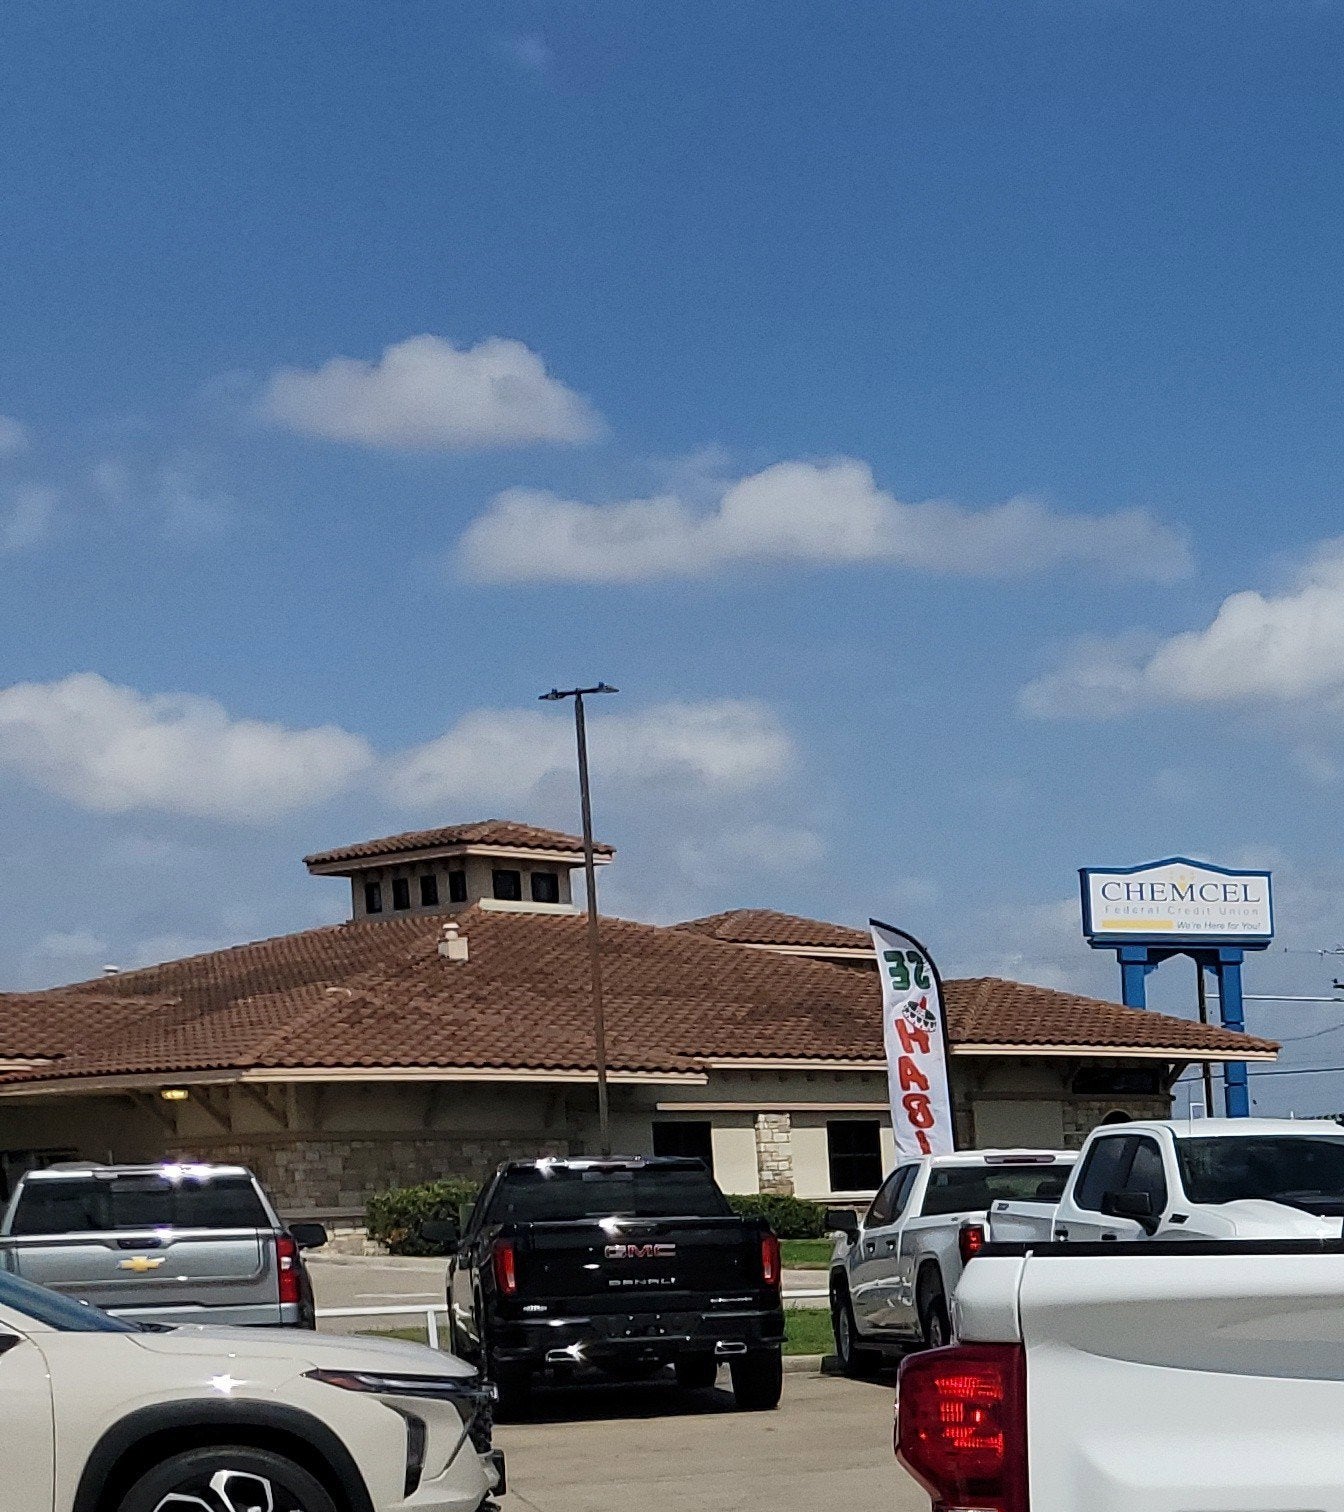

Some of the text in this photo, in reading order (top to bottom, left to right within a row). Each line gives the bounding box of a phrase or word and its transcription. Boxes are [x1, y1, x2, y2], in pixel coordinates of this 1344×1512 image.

[1101, 881, 1260, 903] CHEMCEL
[1104, 904, 1260, 916] Federal Credit Union
[1204, 920, 1226, 930] Here
[1227, 920, 1240, 930] for
[604, 1243, 677, 1259] GMC
